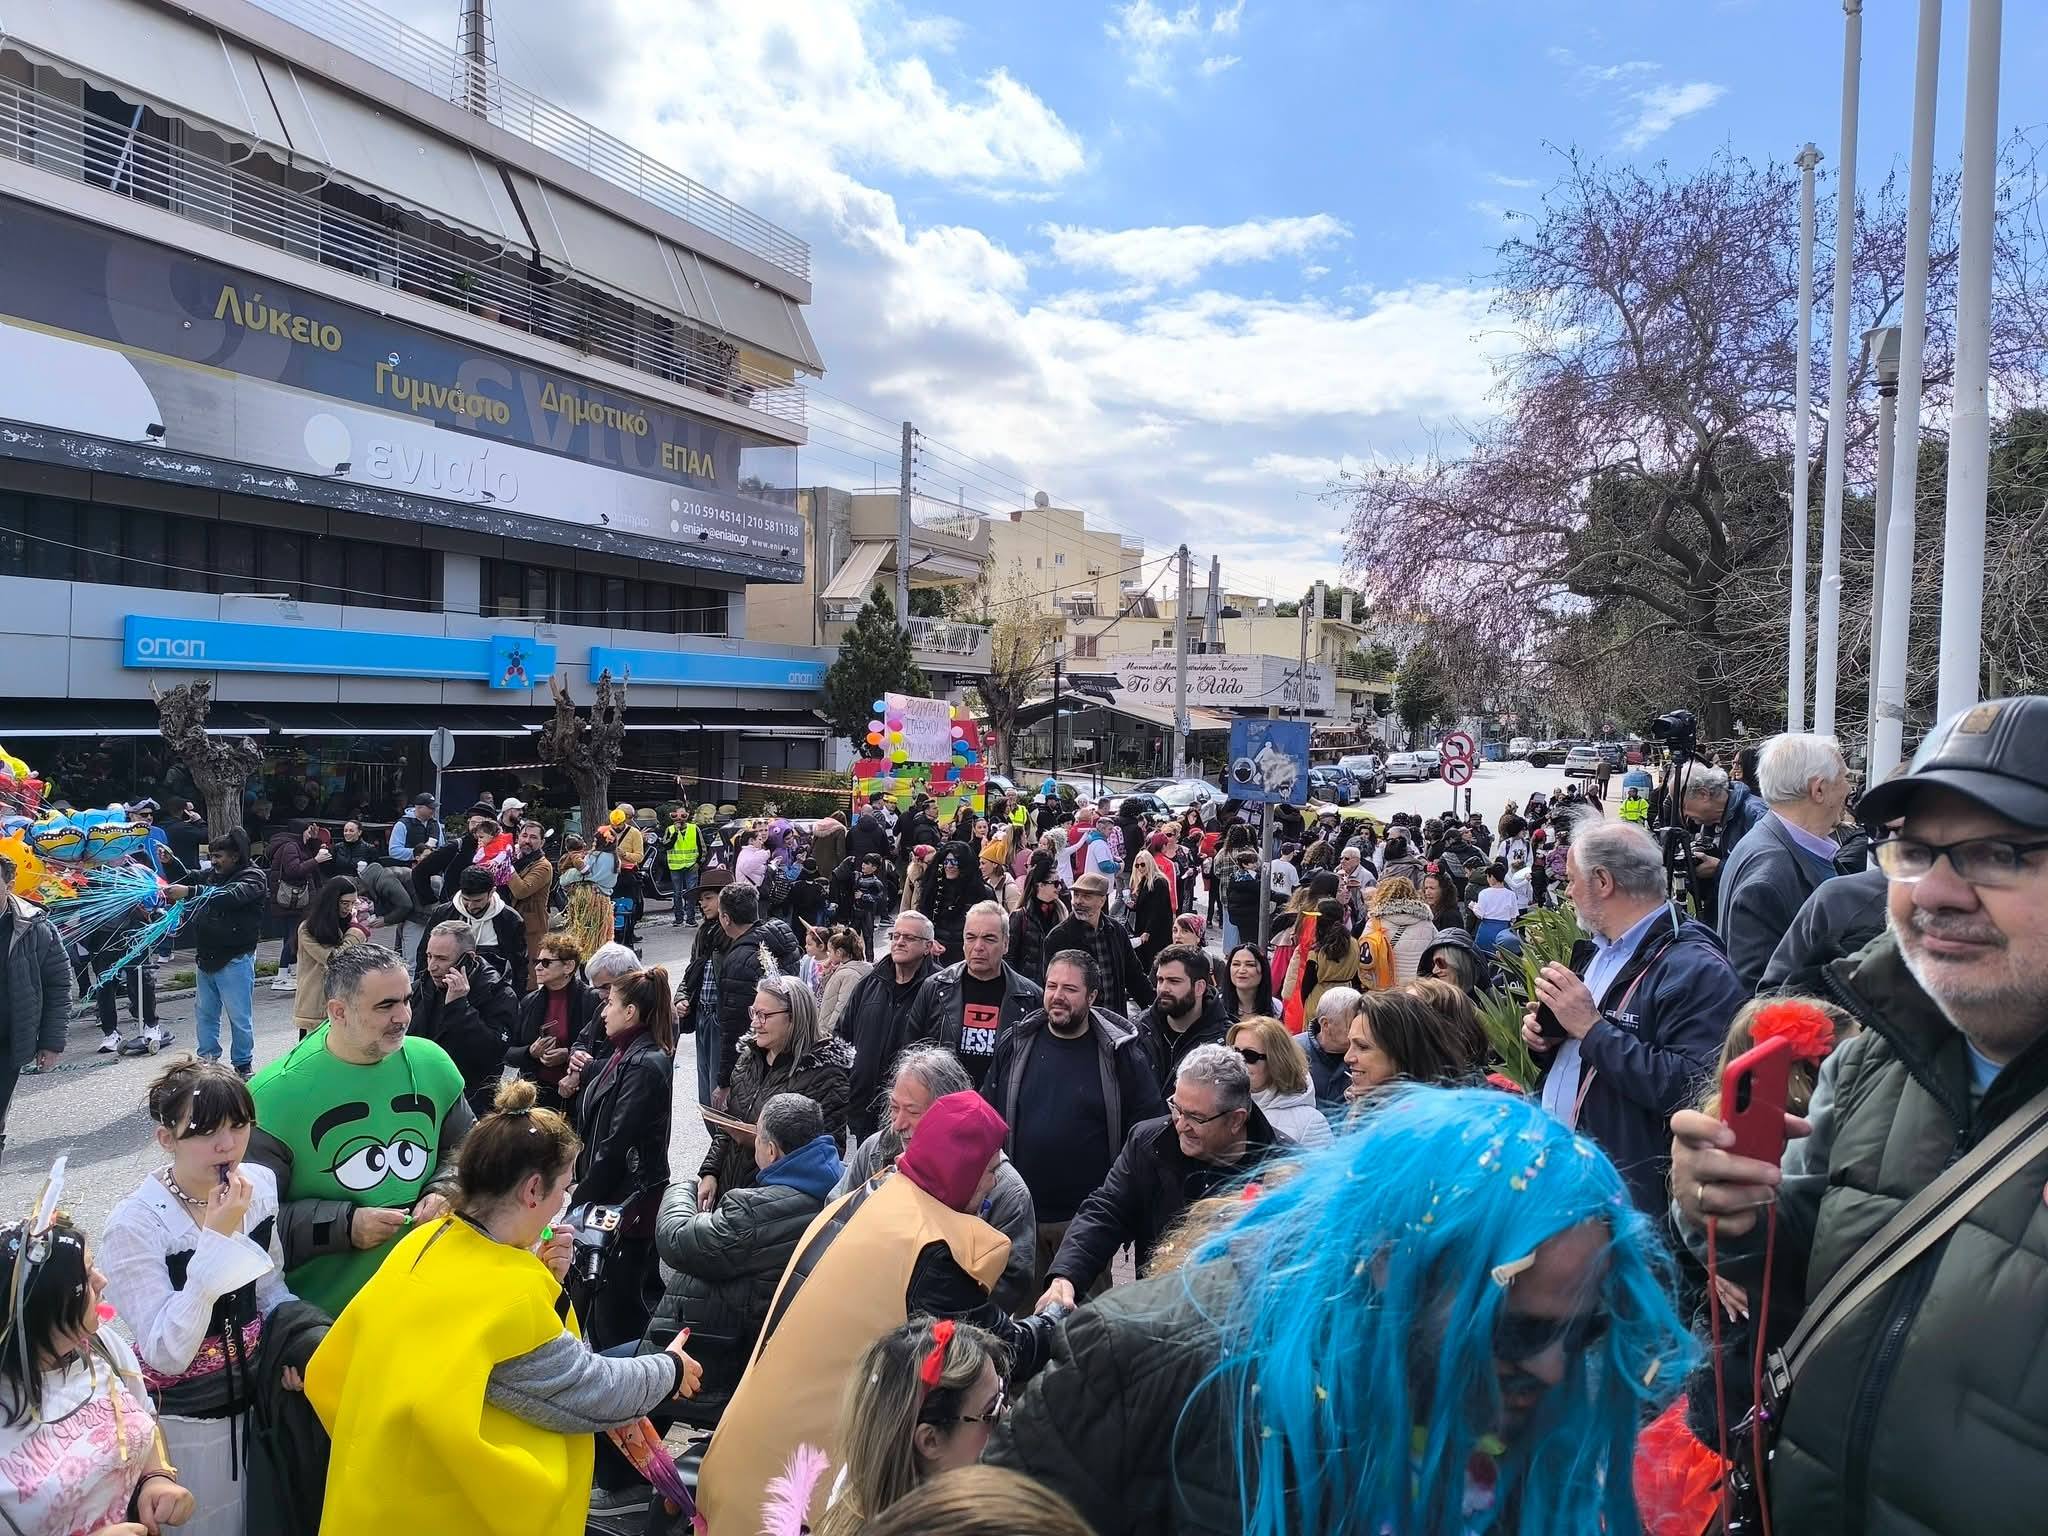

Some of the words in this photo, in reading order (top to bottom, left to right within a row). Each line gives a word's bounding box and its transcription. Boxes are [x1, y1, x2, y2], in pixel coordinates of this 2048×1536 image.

[214, 285, 343, 351] Λύκειο
[375, 361, 511, 425] Γυμνάσιο
[540, 382, 648, 437] Δημοτικό
[367, 439, 519, 503] ενιαίο
[661, 440, 716, 480] ΕΠΑΛ
[683, 502, 701, 516] 210
